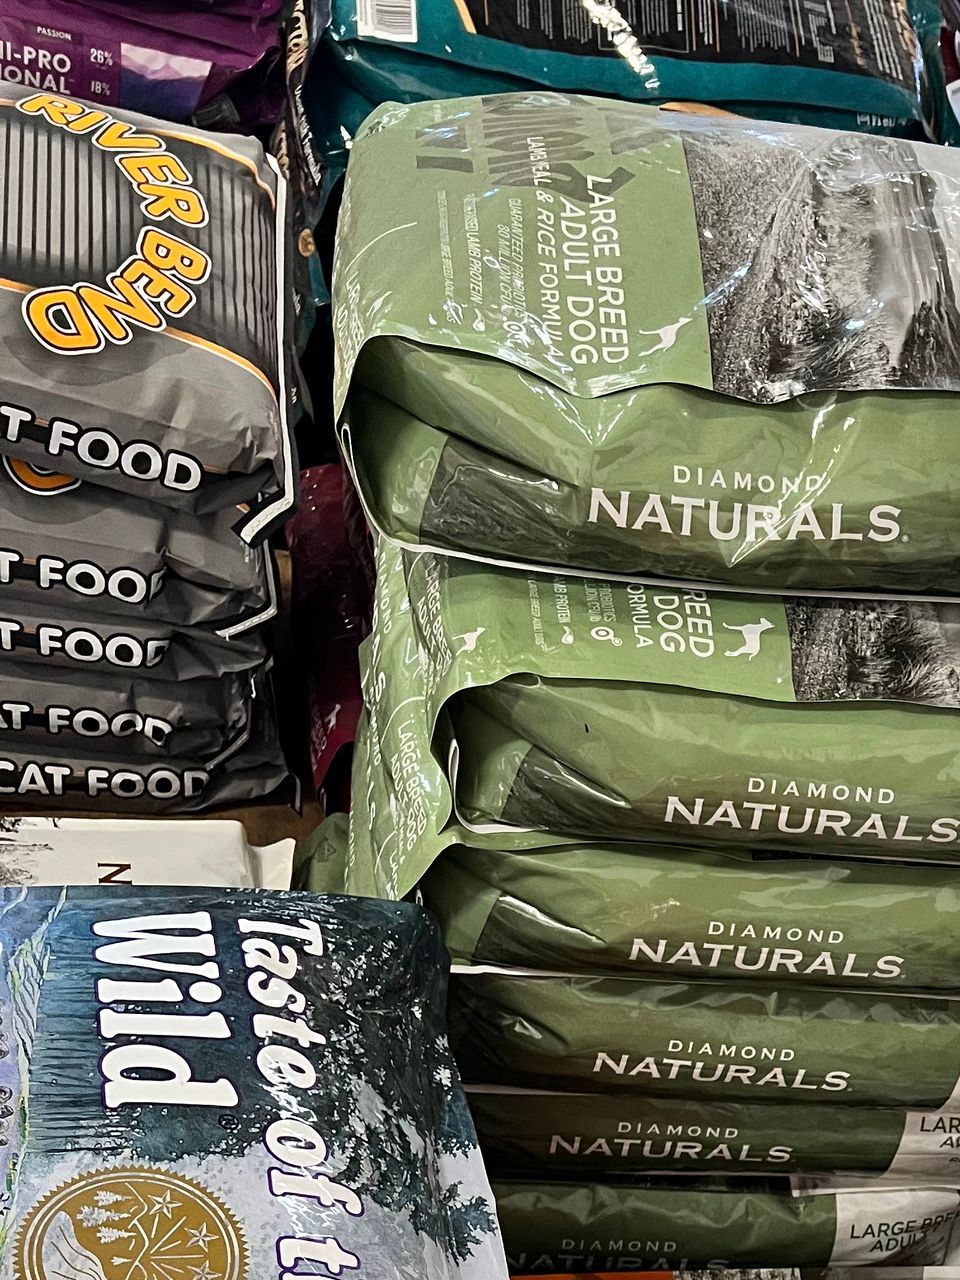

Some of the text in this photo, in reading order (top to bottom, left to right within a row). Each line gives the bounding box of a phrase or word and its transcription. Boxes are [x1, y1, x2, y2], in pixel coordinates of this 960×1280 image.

[37, 26, 71, 41] PASSION
[90, 48, 113, 66] 26%
[91, 80, 110, 96] 18%
[538, 190, 554, 203] &
[15, 92, 212, 355] RIVER BEND
[537, 209, 557, 258] RICE
[469, 258, 485, 304] PROTEIN
[559, 197, 598, 365] ADULT DOG
[586, 175, 629, 364] LARGE BREED
[48, 420, 202, 492] FOOD
[673, 465, 822, 494] DIAMOND
[587, 488, 902, 542] NATURALS
[378, 551, 392, 633] DIAMOND
[425, 562, 441, 611] LARGE
[626, 583, 654, 648] ORMULA
[653, 595, 686, 653] DOG
[48, 707, 173, 746] FOOD
[88, 768, 209, 799] FOOD
[398, 721, 427, 836] LARGE BREED
[747, 778, 895, 805] DIAMOND
[664, 796, 960, 843] NATURALS
[708, 922, 844, 944] DIAMOND
[628, 938, 904, 978] NATURALS
[90, 909, 240, 1111] Wild
[238, 917, 324, 1089] Taste
[593, 1052, 850, 1092] NATURALS
[668, 1040, 795, 1062] DIAMOND
[549, 1135, 793, 1163] NATURALS
[618, 1122, 739, 1139] DIAMOND
[263, 1114, 365, 1218] of
[562, 1238, 677, 1253] DIAMOND
[850, 1221, 917, 1239] LARGE
